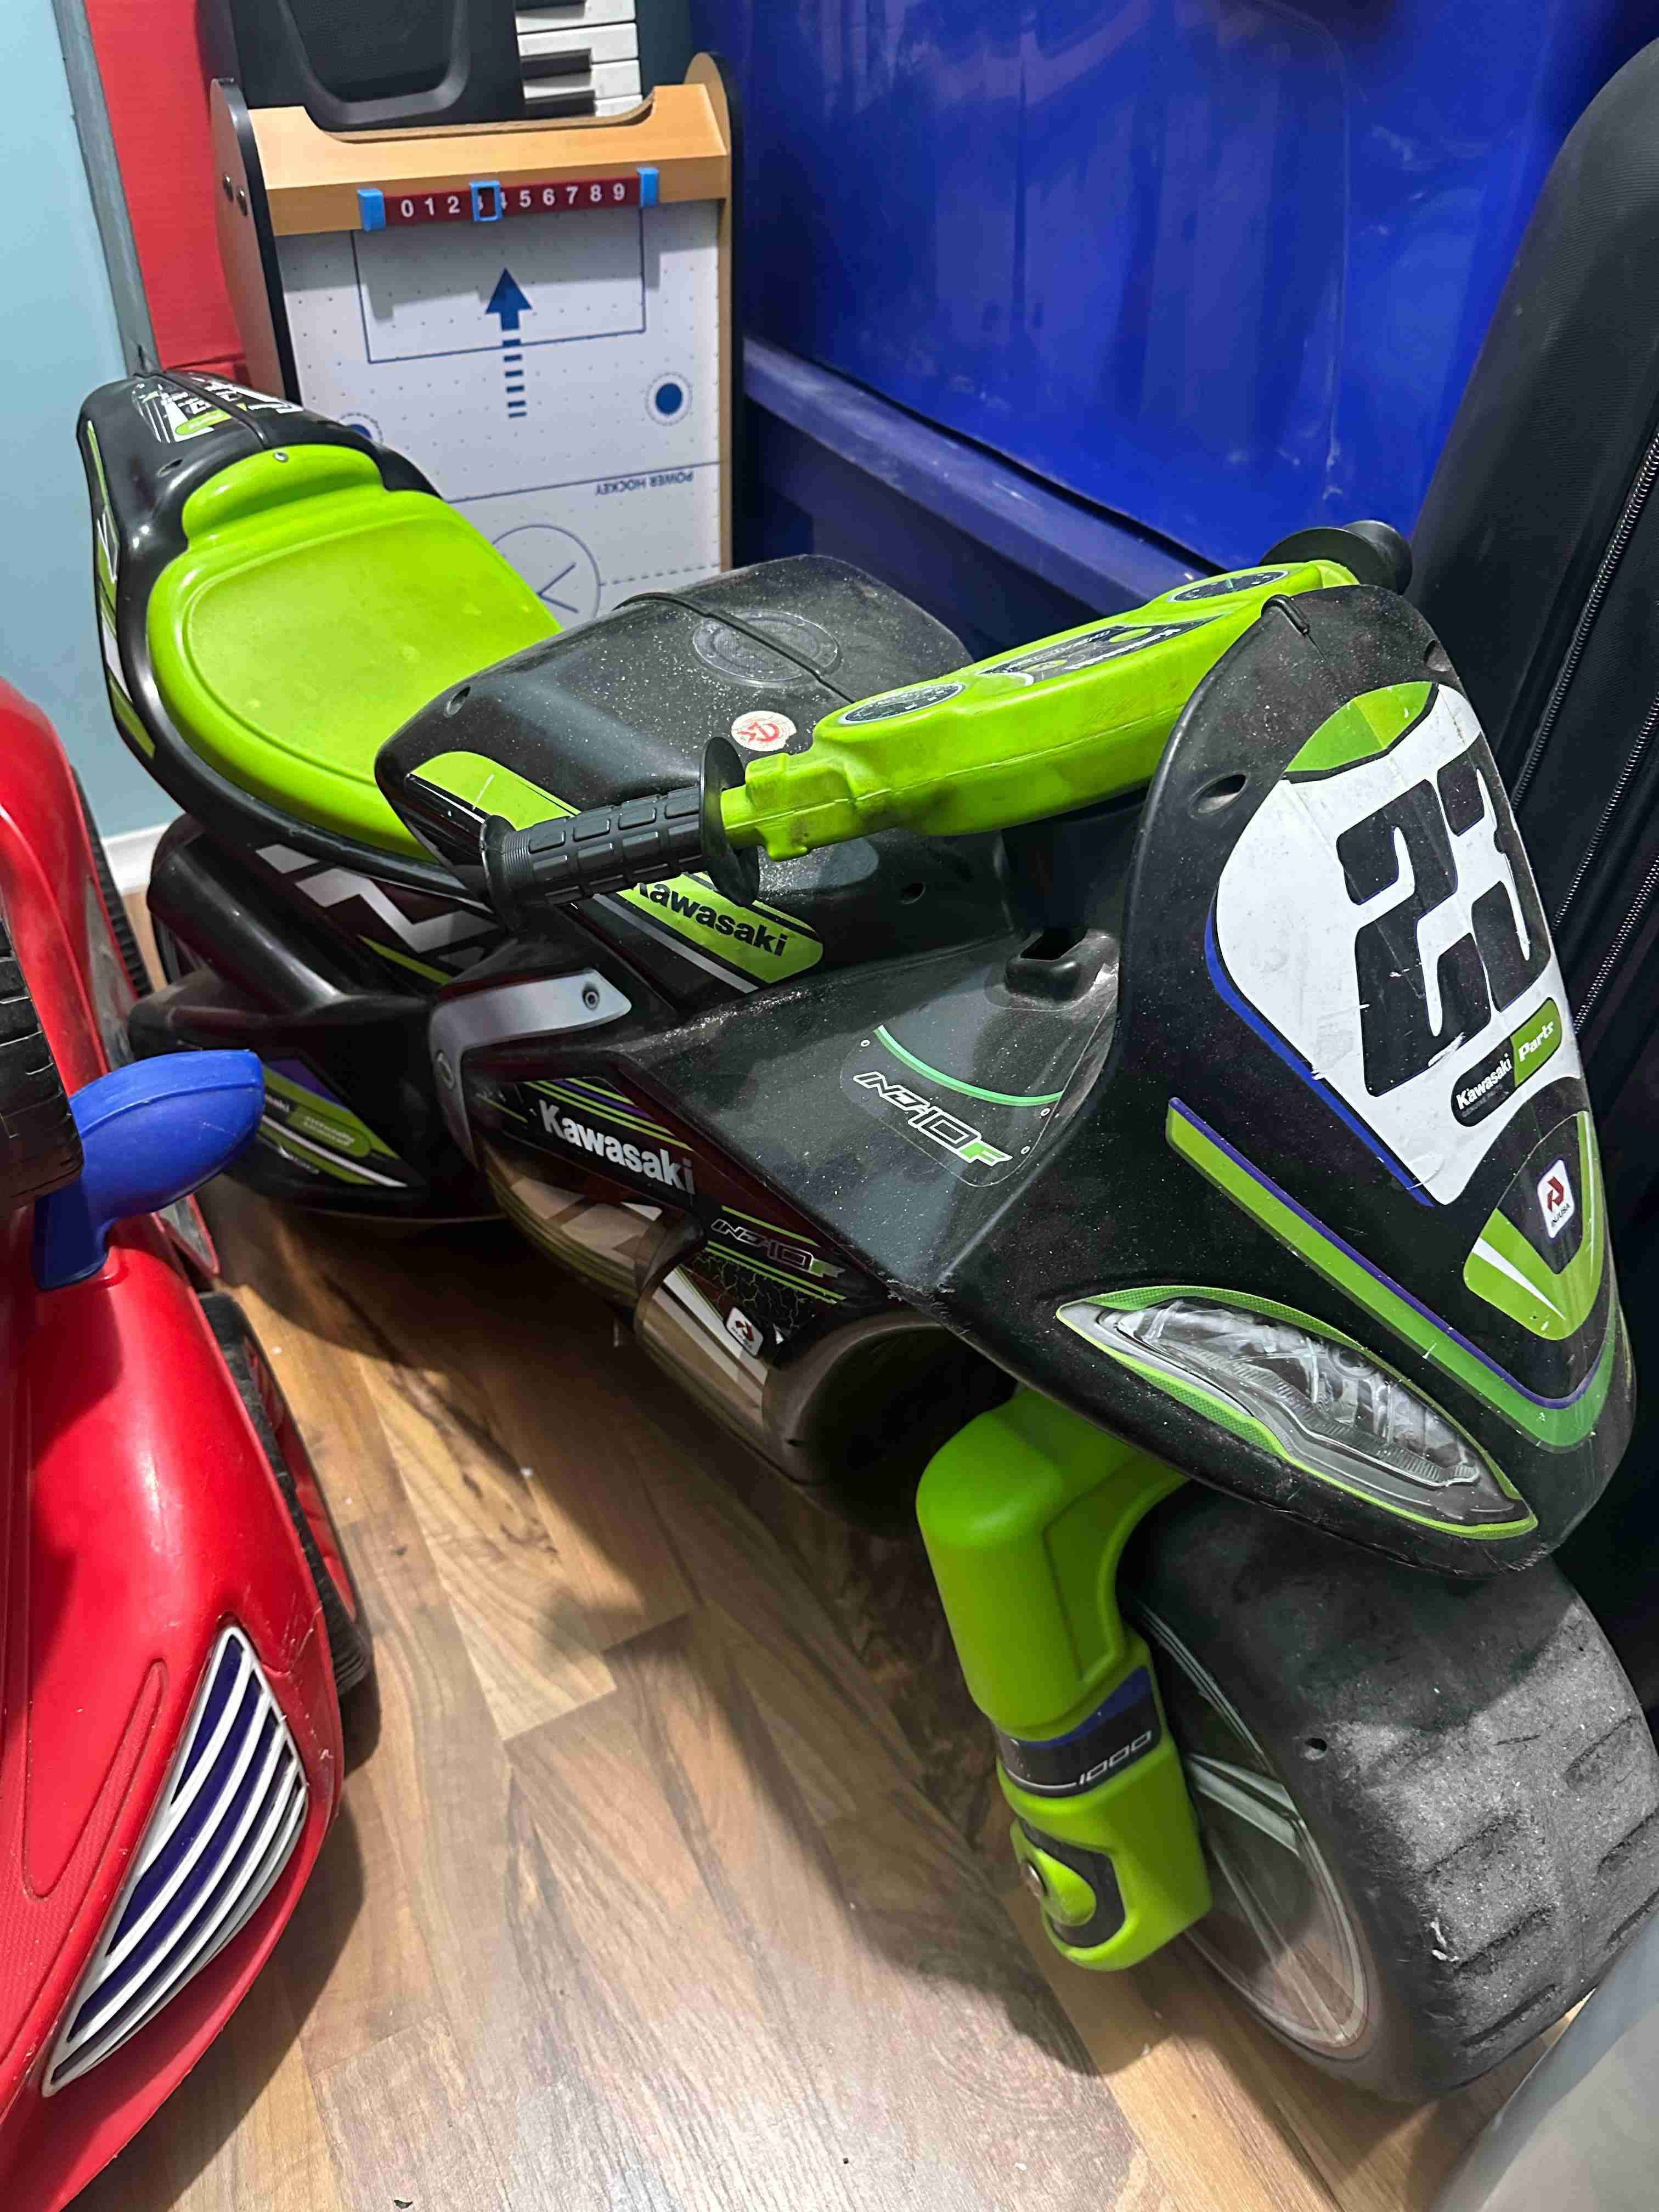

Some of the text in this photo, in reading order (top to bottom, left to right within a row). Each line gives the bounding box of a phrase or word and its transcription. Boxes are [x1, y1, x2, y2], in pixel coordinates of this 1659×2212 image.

[401, 199, 414, 217] 0
[425, 198, 435, 216] 1
[447, 196, 460, 213] 2
[519, 190, 532, 208] 5
[543, 188, 555, 205] 6
[566, 186, 579, 204] 7
[590, 184, 602, 202] 8
[613, 183, 625, 200] 9
[595, 471, 693, 495] POWER HOCKEY
[640, 882, 789, 956] awasaki
[1456, 1053, 1513, 1110] Kawasaki
[1519, 1021, 1554, 1062] Parts
[539, 1098, 696, 1194] Kawasaki
[1079, 1730, 1152, 1785] 1000
